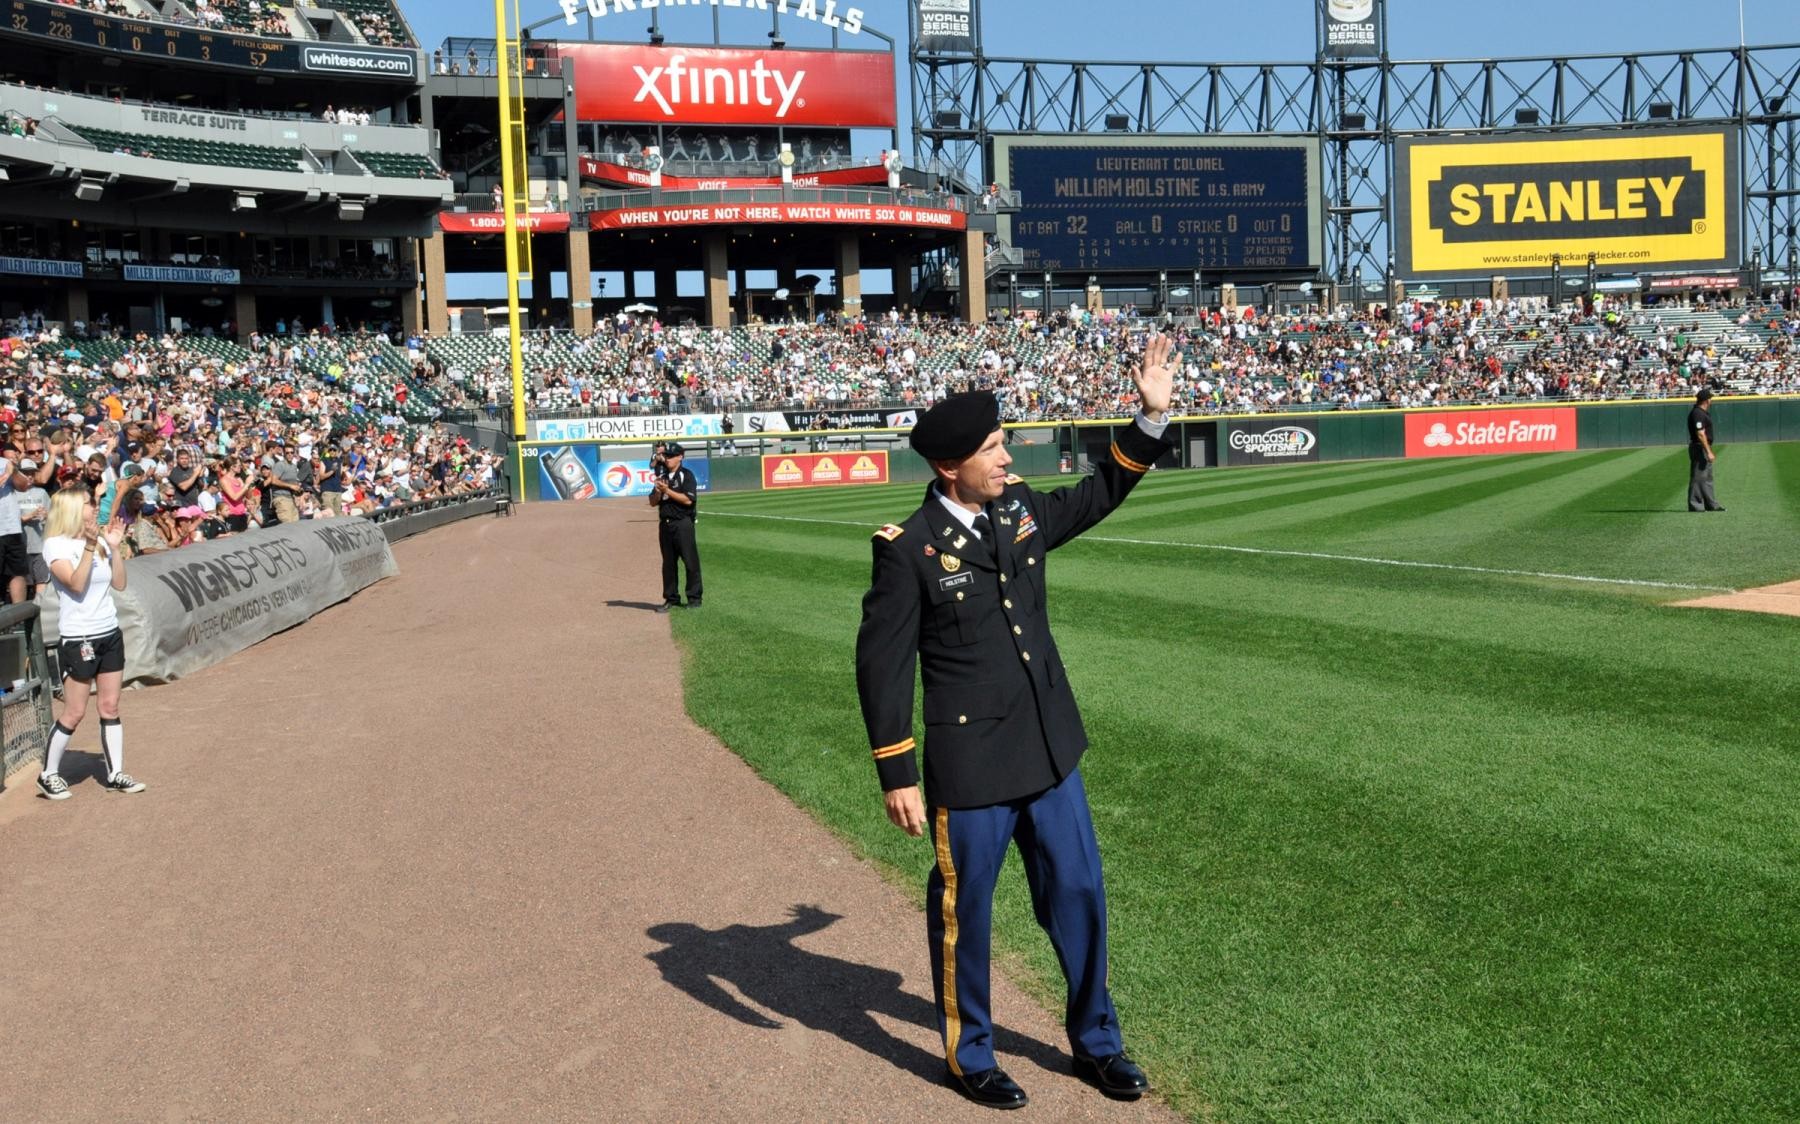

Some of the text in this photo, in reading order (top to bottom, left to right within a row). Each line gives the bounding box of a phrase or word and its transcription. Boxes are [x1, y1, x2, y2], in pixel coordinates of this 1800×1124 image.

[12, 14, 28, 32] 32
[922, 13, 968, 22] WORLD
[122, 24, 153, 35] STRIKE
[164, 29, 180, 38] OUT
[922, 22, 969, 31] SERIES
[98, 31, 106, 46] 0
[1328, 31, 1374, 40] SERIES
[132, 36, 142, 52] 0
[167, 41, 176, 56] 0
[232, 39, 284, 52] PITCH COUNT
[201, 46, 210, 60] 3
[310, 52, 408, 71] whitesox.com
[632, 55, 806, 118] xfinity
[141, 109, 246, 131] TERRACE SUITE
[586, 162, 596, 174] TV
[1096, 157, 1225, 170] LIEUTENANT COLONEL
[627, 171, 651, 185] INTERN
[792, 176, 819, 188] HOME
[1055, 177, 1265, 198] WILLIAM HOLSTINE U.S. ARMY
[1450, 176, 1685, 226] STANLEY
[620, 207, 952, 224] WHEN YOU'RE NOT HERE, WATCH WHITE SOX ON DEMAND!
[1254, 214, 1290, 232] OUT 0
[1018, 216, 1088, 234] AT BAT 32
[1116, 216, 1162, 234] BALL 0
[1178, 215, 1238, 234] STRIKE 0
[1244, 236, 1292, 244] PITCHERS
[25, 260, 40, 273] LITE
[42, 262, 63, 275] EXTRA
[64, 263, 81, 276] BASE
[126, 266, 154, 280] MILLER
[156, 268, 171, 280] LITE
[172, 268, 194, 281] EXTRA
[195, 269, 213, 282] BASE
[588, 418, 684, 434] HOME FIELD
[522, 448, 538, 457] 330
[1244, 442, 1304, 454] SPORTSNET
[220, 596, 272, 632] CHICAGO'S
